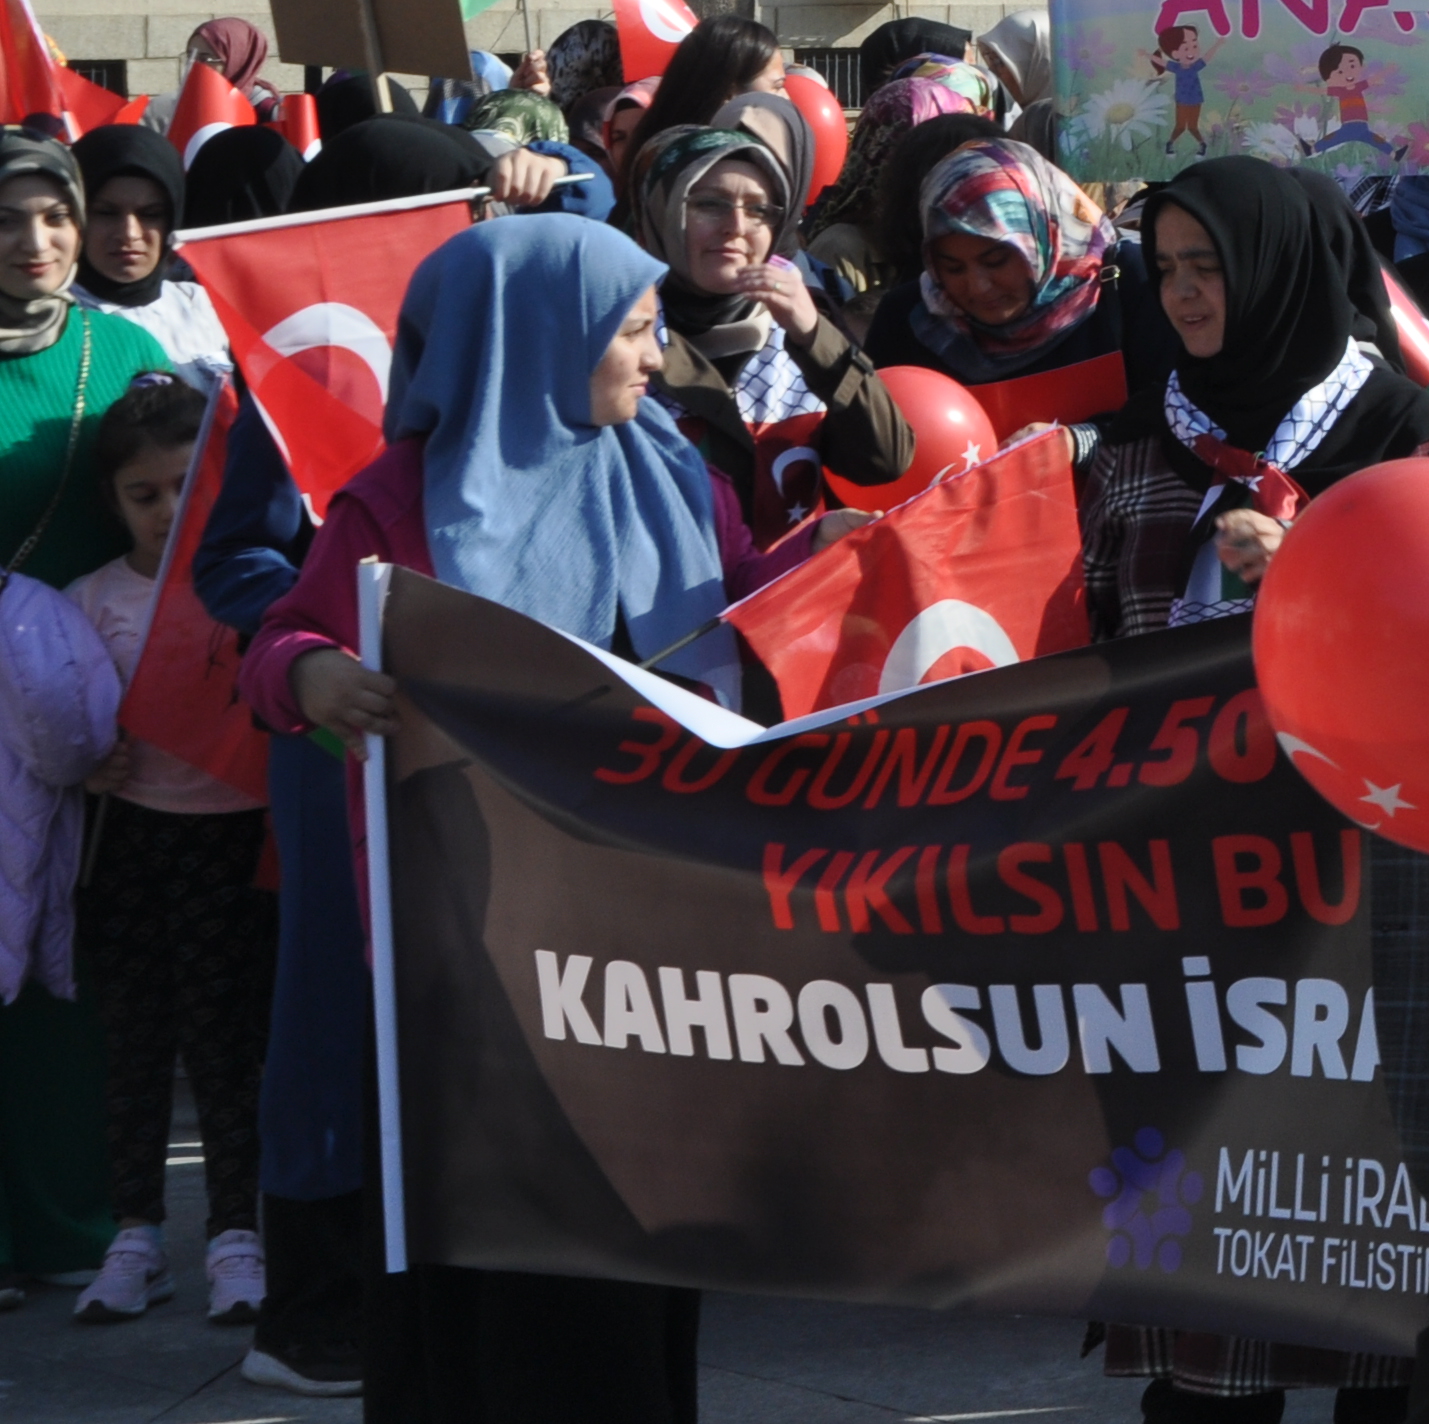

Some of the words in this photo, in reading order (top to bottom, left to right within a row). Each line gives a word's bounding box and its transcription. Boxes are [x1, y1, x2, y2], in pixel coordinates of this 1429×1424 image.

[745, 709, 1057, 813] GÜNDE
[761, 839, 1179, 935] YIKILSIN
[1212, 828, 1362, 930] BU
[533, 948, 1162, 1078] KAHROLSUN
[1213, 1227, 1315, 1283] TOKAT
